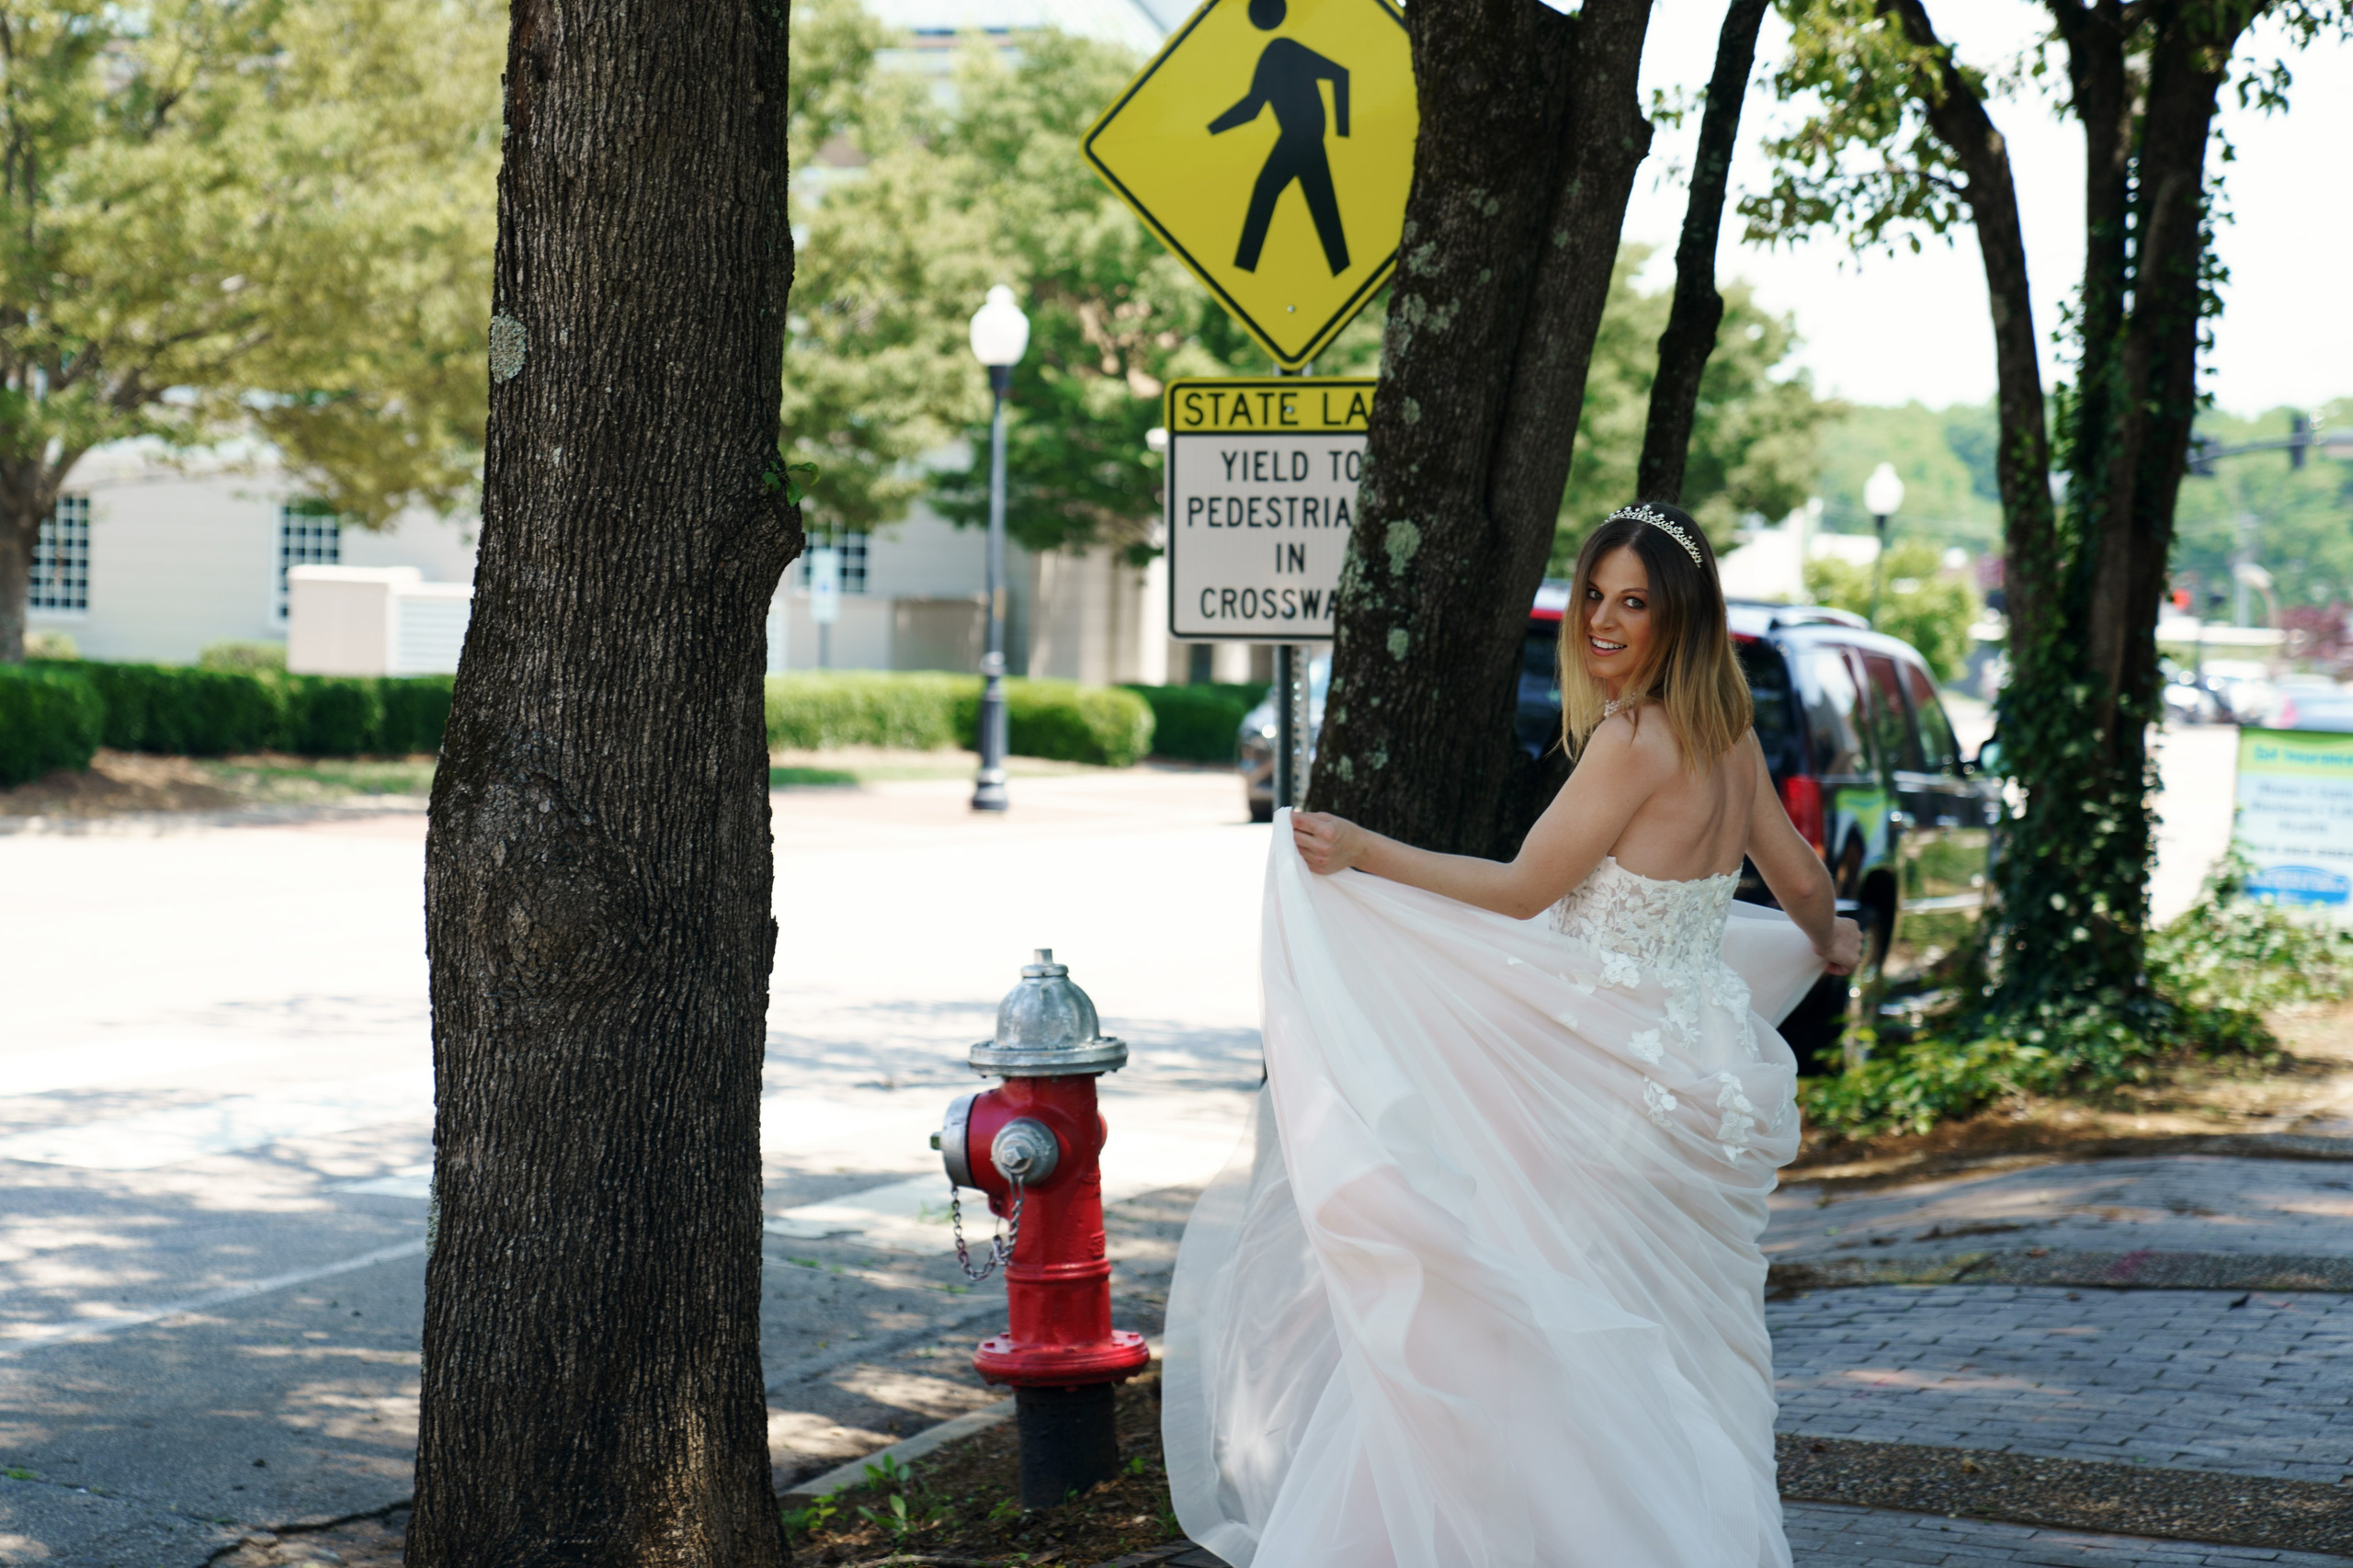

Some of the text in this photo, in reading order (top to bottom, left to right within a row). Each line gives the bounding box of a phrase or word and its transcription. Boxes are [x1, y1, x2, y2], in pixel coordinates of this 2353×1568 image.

[1184, 392, 1377, 426] STATE LA
[1222, 451, 1361, 482] YIELD TO
[1188, 497, 1351, 528] PEDESTRIA
[1276, 543, 1305, 574] IN
[1200, 588, 1337, 619] CROSSWA
